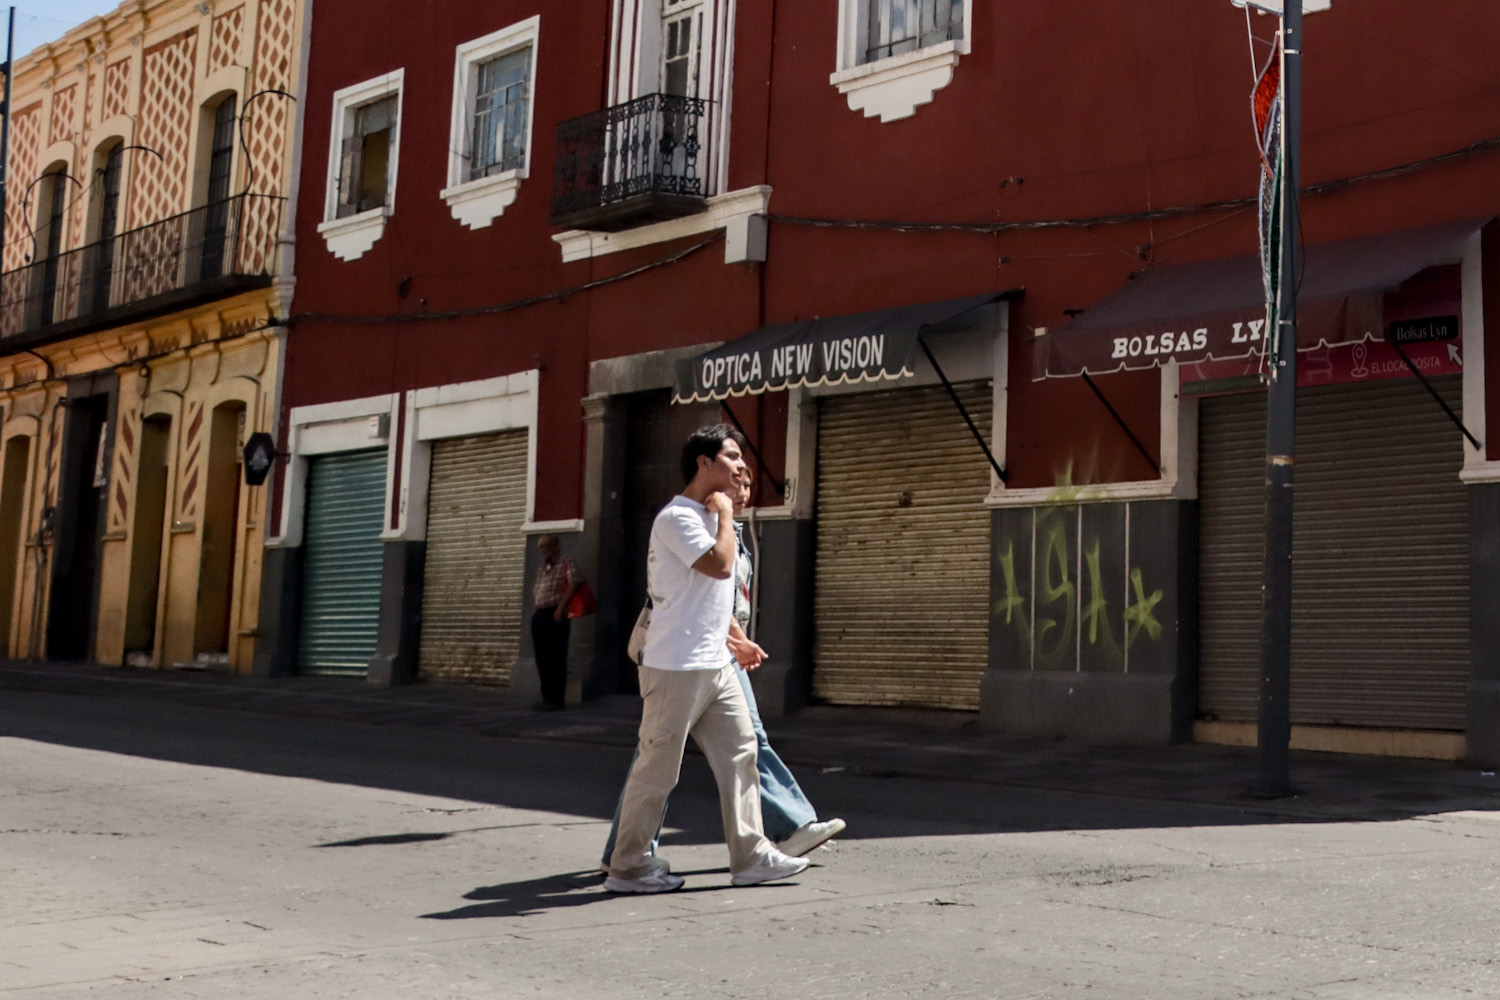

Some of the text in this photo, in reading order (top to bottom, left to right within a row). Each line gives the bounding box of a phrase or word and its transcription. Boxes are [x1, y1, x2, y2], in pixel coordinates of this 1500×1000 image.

[1111, 319, 1266, 359] BOLSAS LY
[1396, 323, 1447, 342] Bolsas Lyn
[771, 343, 814, 378] NEW
[823, 334, 884, 372] VISION
[1371, 361, 1381, 374] EL
